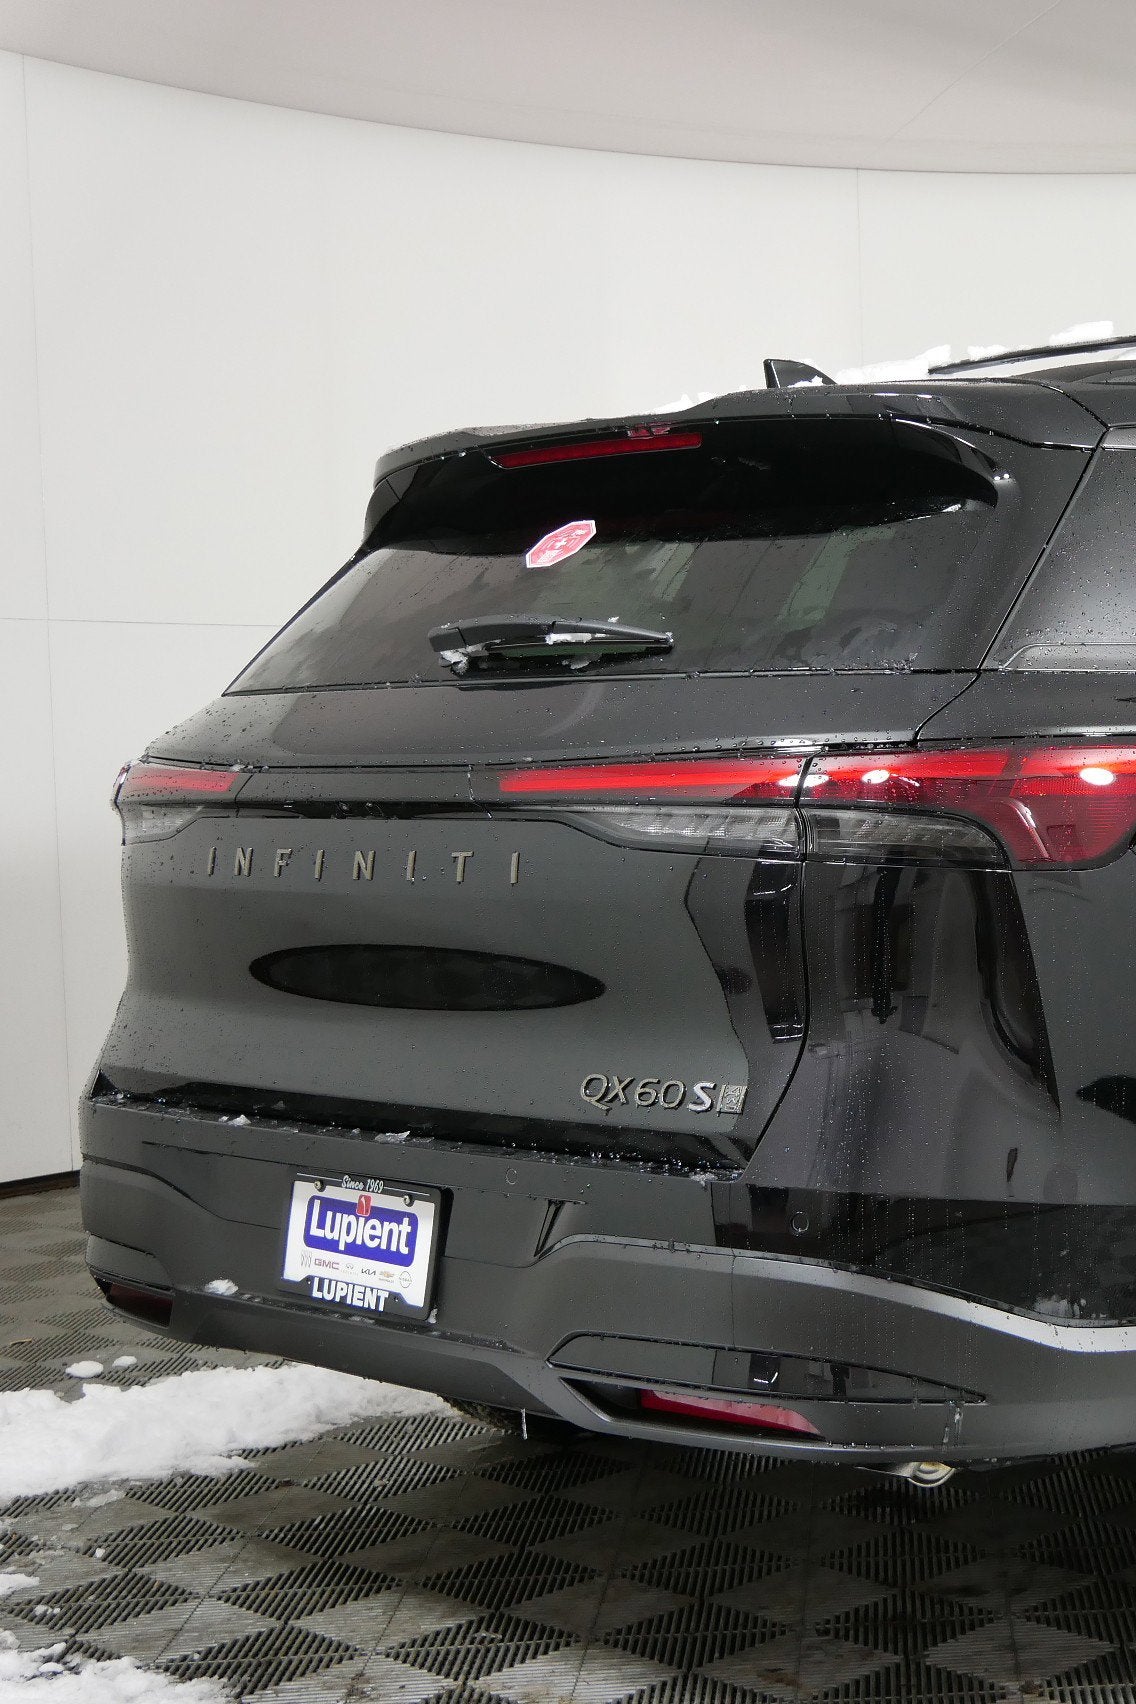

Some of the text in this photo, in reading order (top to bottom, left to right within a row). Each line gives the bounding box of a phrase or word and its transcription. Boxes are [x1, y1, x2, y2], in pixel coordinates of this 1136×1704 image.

[207, 846, 520, 885] INFINITI
[341, 1174, 384, 1194] Since 1969
[309, 1199, 412, 1255] Lupient
[314, 1258, 341, 1270] GMC
[311, 1277, 390, 1312] LUPIENT
